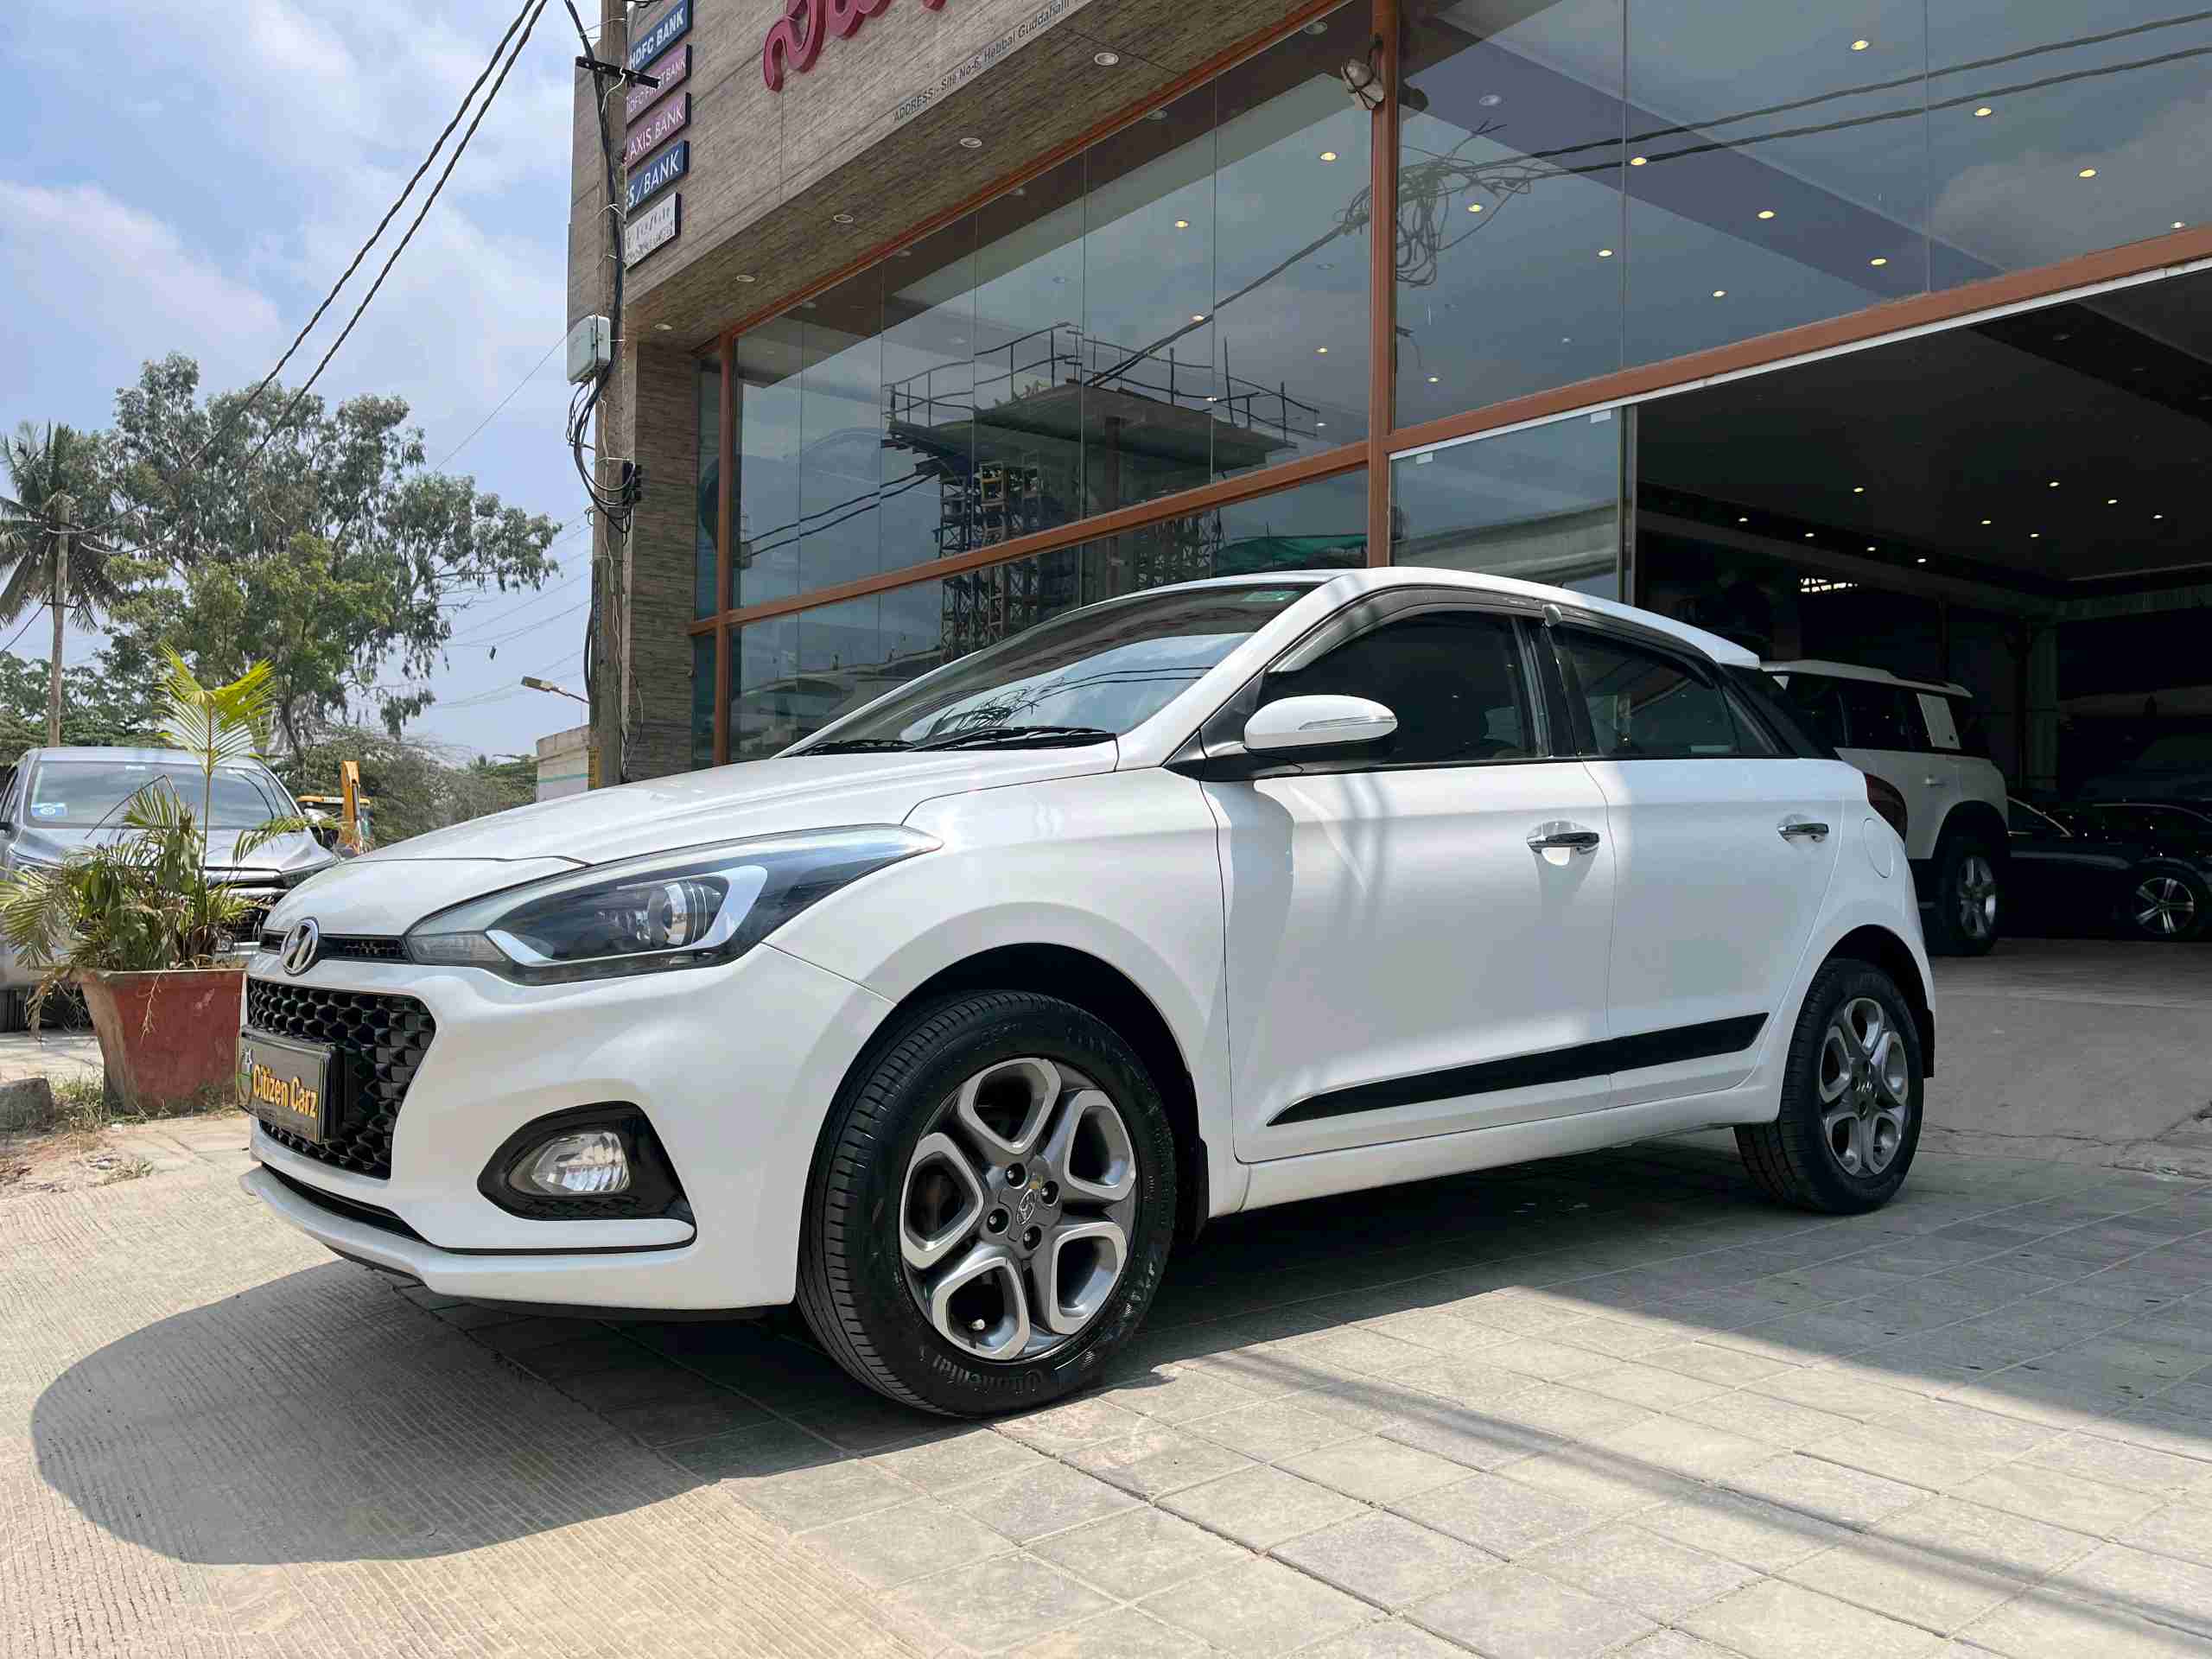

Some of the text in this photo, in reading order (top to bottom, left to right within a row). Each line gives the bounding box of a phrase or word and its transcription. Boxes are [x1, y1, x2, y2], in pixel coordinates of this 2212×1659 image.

[629, 7, 683, 69] HDFC BANK
[630, 103, 683, 160] AXIS BANK
[290, 1076, 319, 1120] Carz
